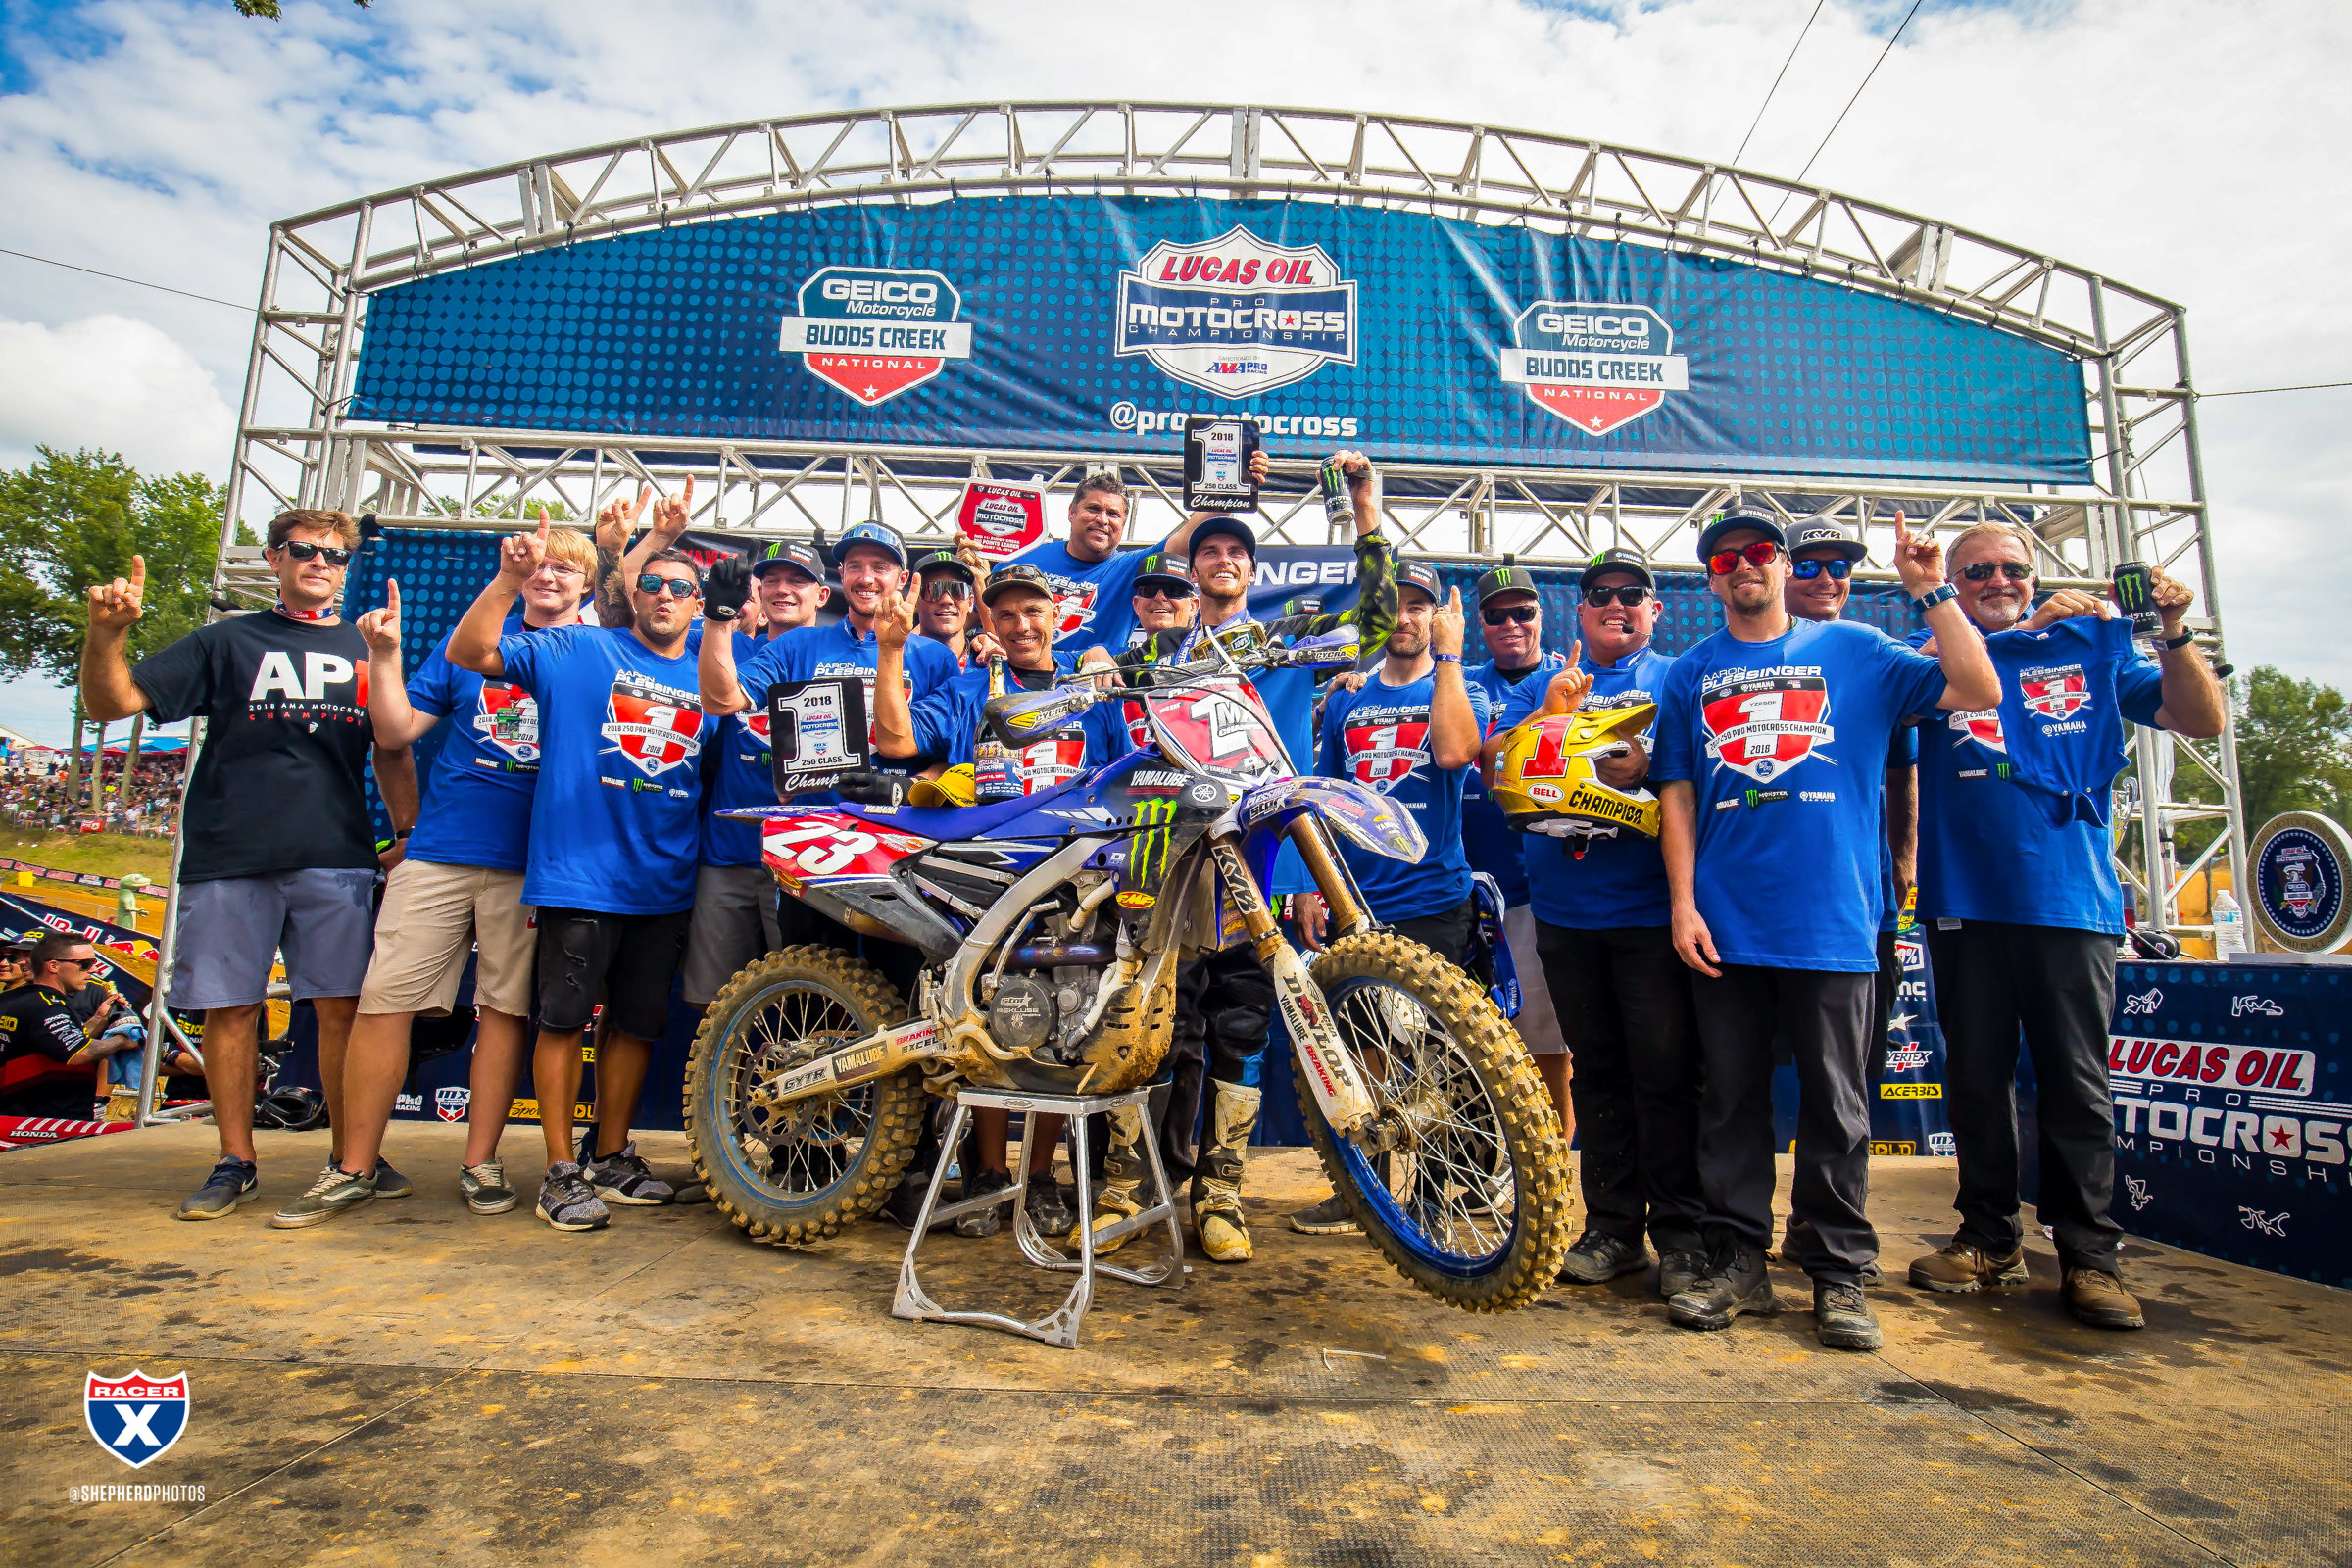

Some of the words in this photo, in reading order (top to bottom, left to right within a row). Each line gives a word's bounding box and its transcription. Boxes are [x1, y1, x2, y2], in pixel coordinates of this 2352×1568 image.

[1159, 256, 1259, 284] LUCAS
[1266, 259, 1313, 285] OIL
[822, 278, 938, 303] GEICO
[846, 300, 936, 318] Motorcycle
[1210, 297, 1265, 307] PRO
[1129, 303, 1345, 331] MOTOCROSS
[1537, 313, 1649, 337] GEICO
[806, 324, 876, 347] BUDDS
[879, 327, 947, 350] CREEK
[1128, 324, 1345, 342] CHAMPIONSHIP
[1562, 334, 1650, 352] Motorcycle
[821, 357, 926, 369] NATIONAL
[1204, 362, 1246, 374] AMA
[1526, 356, 1592, 379] BUDDS
[1598, 360, 1663, 382] CREEK
[1544, 388, 1647, 401] NATIONAL
[1110, 401, 1357, 436] @proocross
[1211, 432, 1233, 441] 2018
[987, 487, 1009, 496] LUCAS
[985, 502, 1006, 511] LUCAS
[1191, 495, 1250, 510] Champion
[1314, 651, 1347, 660] CYCRA
[617, 668, 656, 683] AARON
[814, 667, 910, 678] PLESSINR
[1703, 666, 1747, 683] AARON
[2020, 663, 2082, 678] PLESSINGER
[1702, 665, 1822, 693] PLESSINGER
[615, 673, 702, 703] PLESSINGER
[803, 696, 832, 707] 2018
[249, 703, 275, 711] 2018
[312, 703, 365, 717] MOTOCROSS
[1348, 705, 1430, 720] PLESSINGER
[1952, 712, 1969, 723] 2018
[647, 727, 676, 740] MOTOCROSS
[1733, 727, 1745, 738] PRO
[1746, 723, 1788, 734] MOTOCROSS
[1789, 724, 1827, 735] CHAMPION
[2052, 721, 2087, 732] YAMAHA
[646, 745, 662, 754] 2018
[1520, 714, 1575, 779] 1
[1750, 744, 1771, 755] 2018
[817, 756, 843, 764] CLASS
[1032, 766, 1063, 775] MOTOCROSS
[1209, 765, 1232, 774] YAMAHA
[1373, 767, 1388, 776] 2018
[785, 773, 840, 792] Champ
[1130, 770, 1188, 787] YAMALUBE
[1533, 787, 1558, 798] BELL
[1808, 791, 1836, 801] YAMAHA
[863, 804, 900, 815] YAMAHA
[762, 821, 879, 875] 23
[1210, 844, 1261, 915] KYB
[1117, 892, 1156, 906] FMF
[1279, 993, 1309, 1044] YAMALUBE
[896, 1029, 935, 1047] BRAKIN
[901, 1038, 939, 1054] EXCEL
[836, 1047, 885, 1073] YAMALUBE
[1887, 1051, 1931, 1063] VERTEX
[1304, 1044, 1337, 1098] BRAKING
[2109, 1039, 2230, 1083] LUCAS
[2235, 1049, 2304, 1091] OIL
[784, 1066, 828, 1092] GYTR
[1883, 1086, 1940, 1097] ACERBIS
[2149, 1083, 2241, 1107] PRO
[9, 1130, 59, 1139] HONDA
[2113, 1095, 2352, 1166] TOCROS
[2117, 1135, 2352, 1186] MPIONSH
